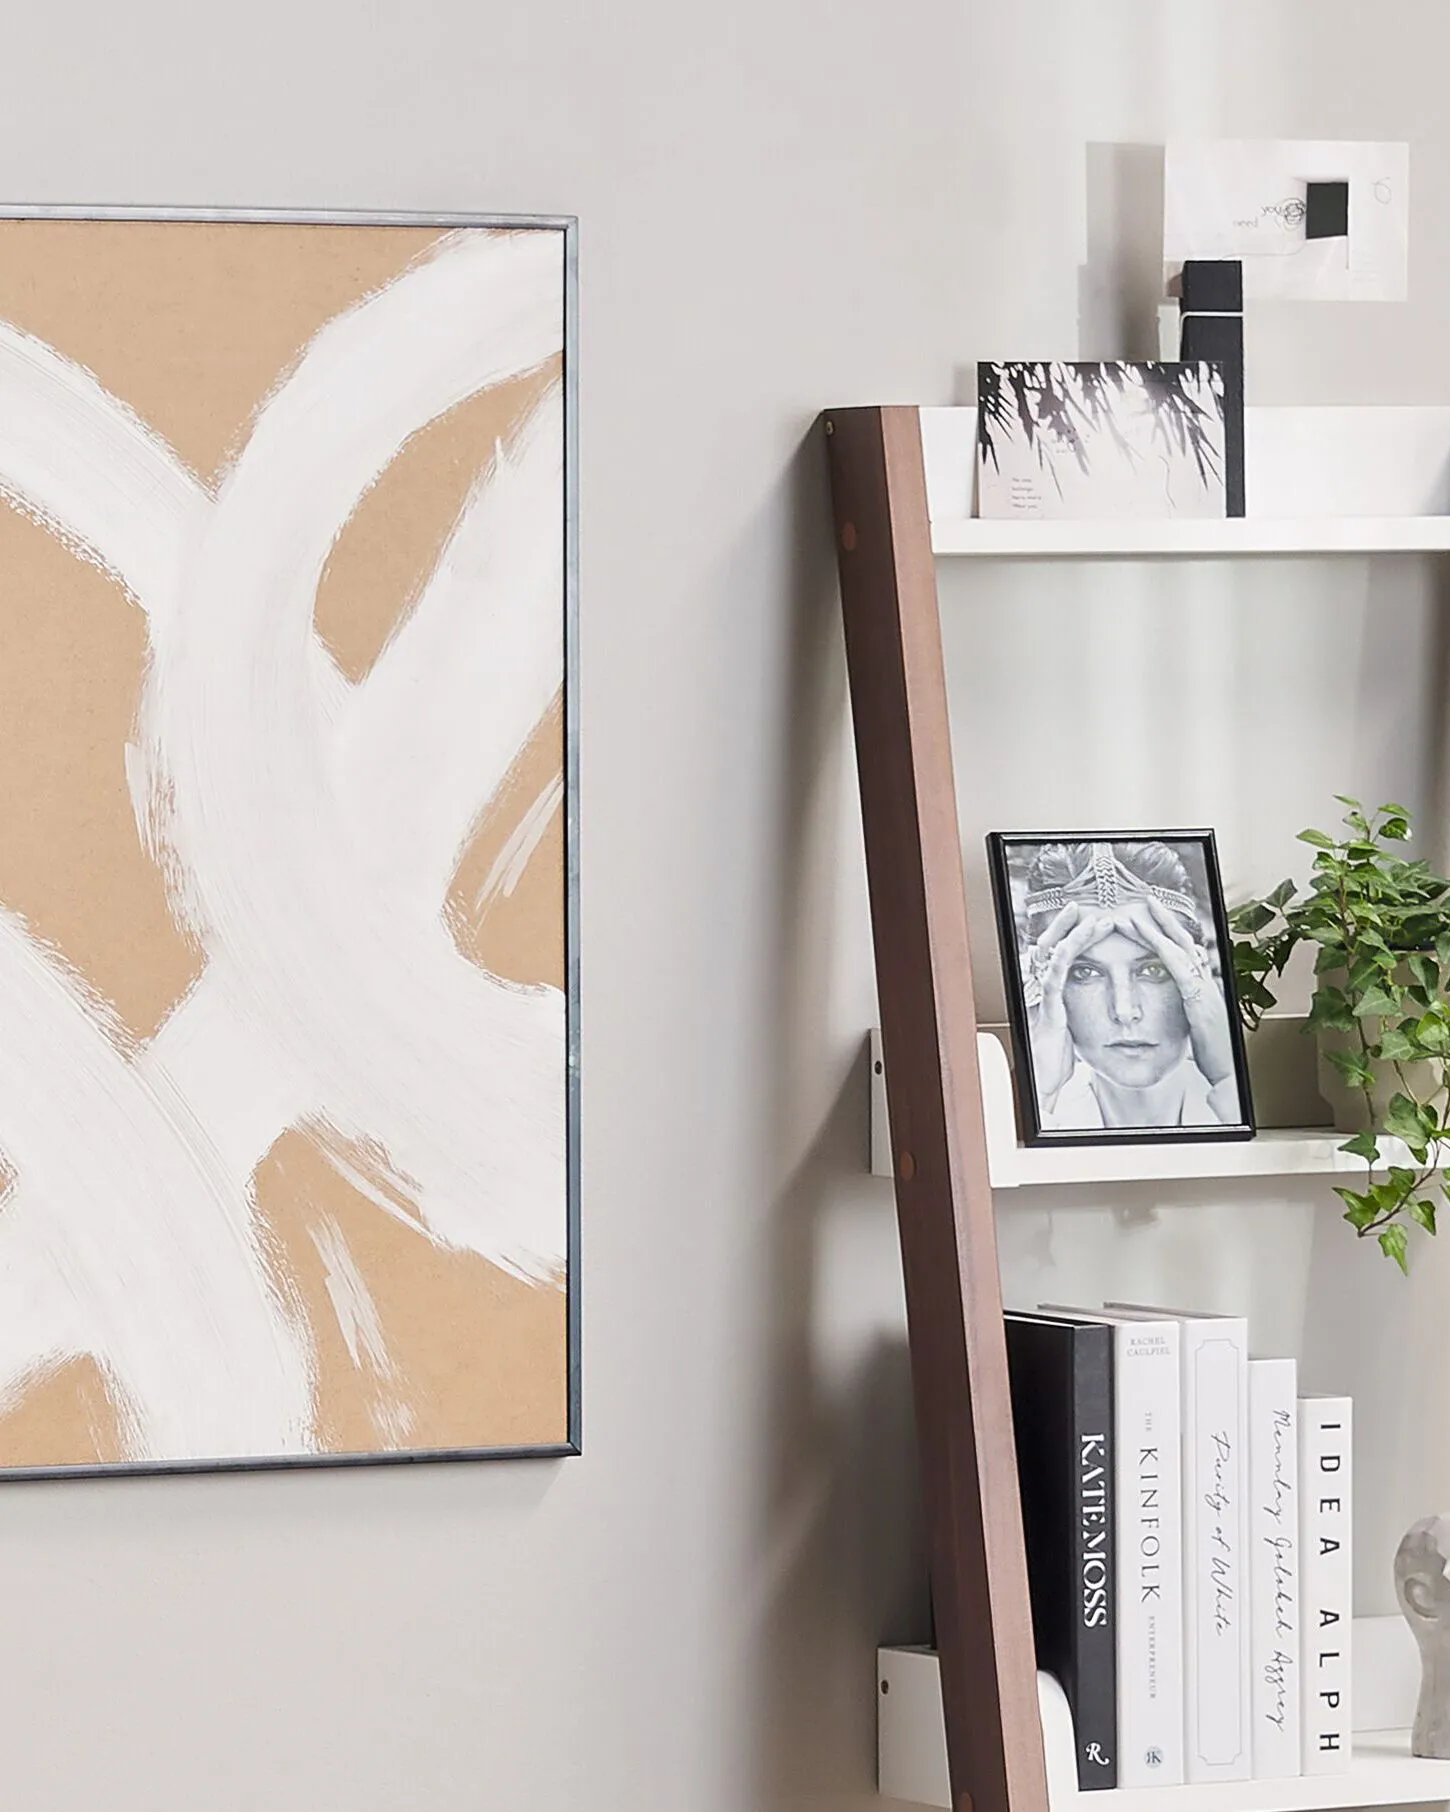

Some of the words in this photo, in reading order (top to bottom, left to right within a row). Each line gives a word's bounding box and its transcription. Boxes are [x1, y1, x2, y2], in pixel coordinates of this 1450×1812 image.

[1081, 1434, 1106, 1526] KATE
[1204, 1430, 1232, 1518] Purity
[1319, 1423, 1342, 1556] IDEA
[1138, 1447, 1161, 1604] KINFOLK
[1210, 1526, 1232, 1553] of
[1082, 1531, 1107, 1627] MOSS
[1210, 1556, 1234, 1637] White
[1318, 1609, 1341, 1752] ALPH
[1085, 1742, 1110, 1766] R
